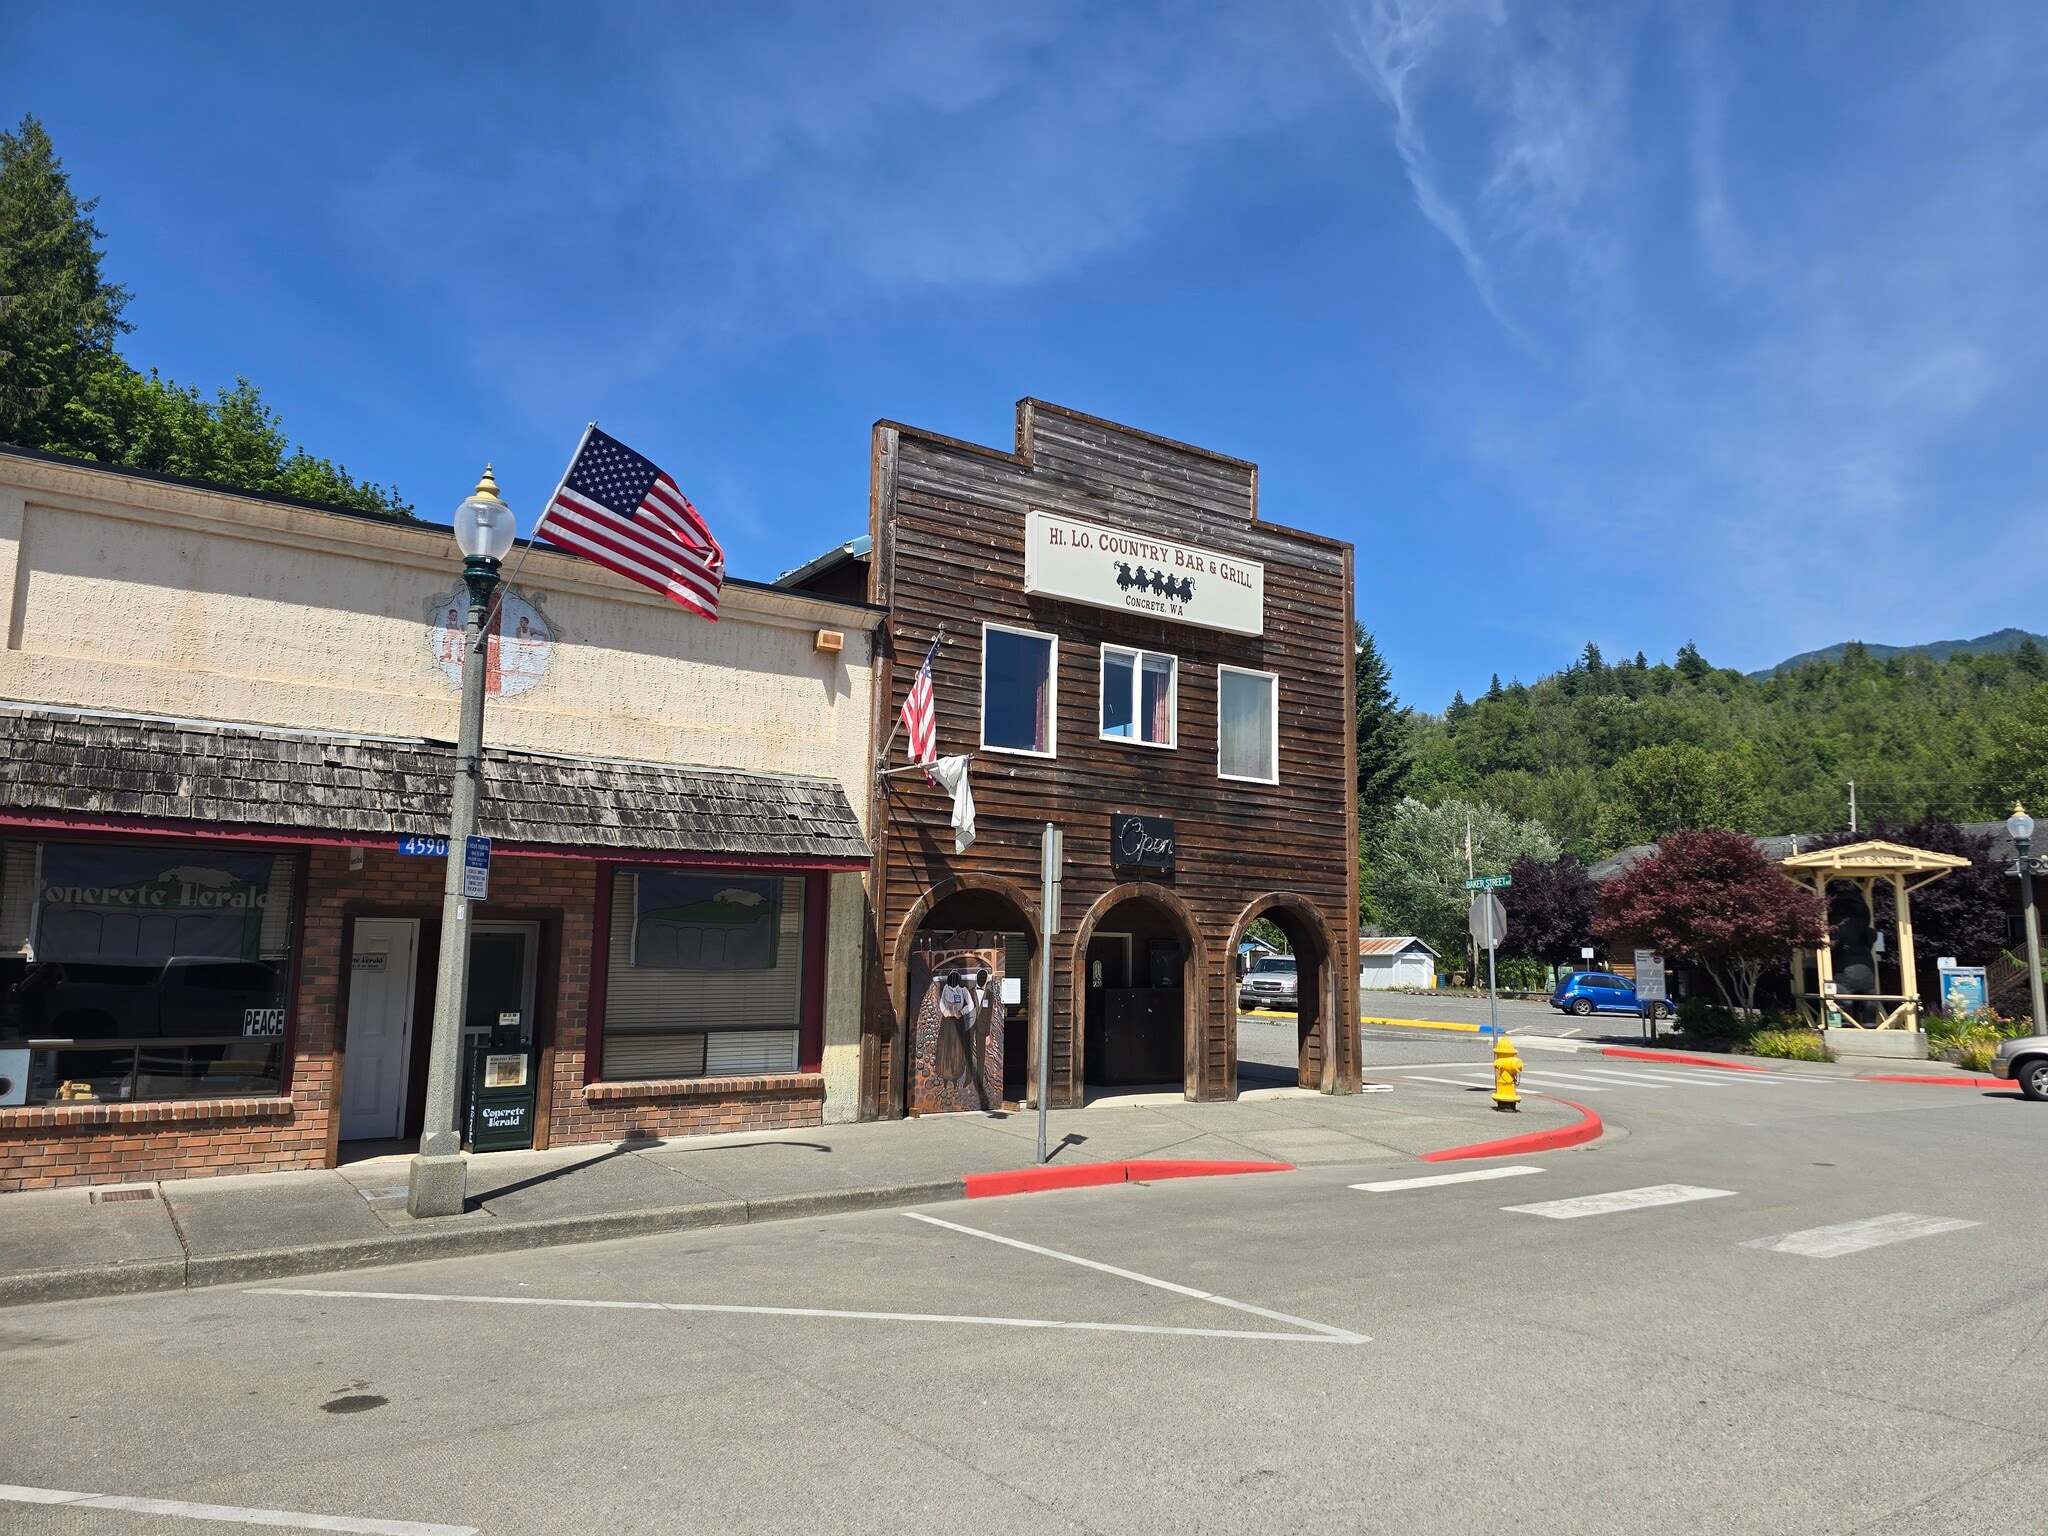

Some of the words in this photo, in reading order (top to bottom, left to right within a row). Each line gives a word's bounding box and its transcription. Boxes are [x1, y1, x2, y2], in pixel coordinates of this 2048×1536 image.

[1071, 529, 1093, 549] LO.
[1098, 533, 1169, 563] COUNTRY
[1174, 549, 1205, 573] BAR
[1209, 560, 1217, 575] &
[1220, 562, 1253, 589] GRILL
[1169, 603, 1184, 616] WA
[405, 837, 450, 855] 4590
[1119, 816, 1174, 862] Open
[1465, 879, 1485, 890] BAKER
[1485, 877, 1505, 889] STREET
[244, 1009, 284, 1035] PEACE
[482, 1106, 526, 1118] Concrete
[486, 1115, 521, 1128] Herald
